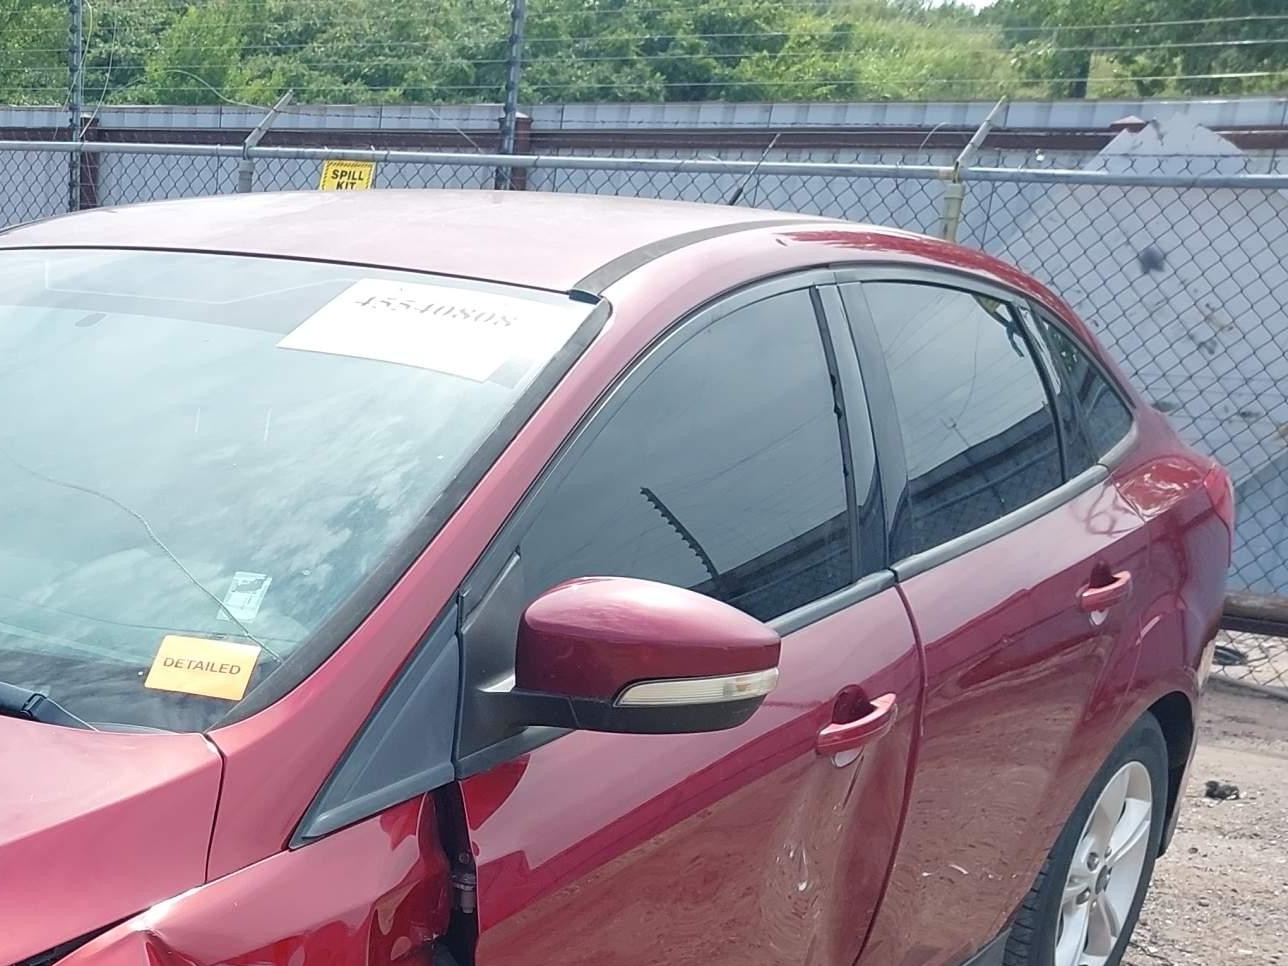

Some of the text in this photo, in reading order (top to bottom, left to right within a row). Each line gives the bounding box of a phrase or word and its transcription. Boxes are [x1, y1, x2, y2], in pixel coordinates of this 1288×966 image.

[331, 169, 364, 181] SPILL
[336, 181, 357, 190] KIT
[163, 657, 241, 675] DETAILED
